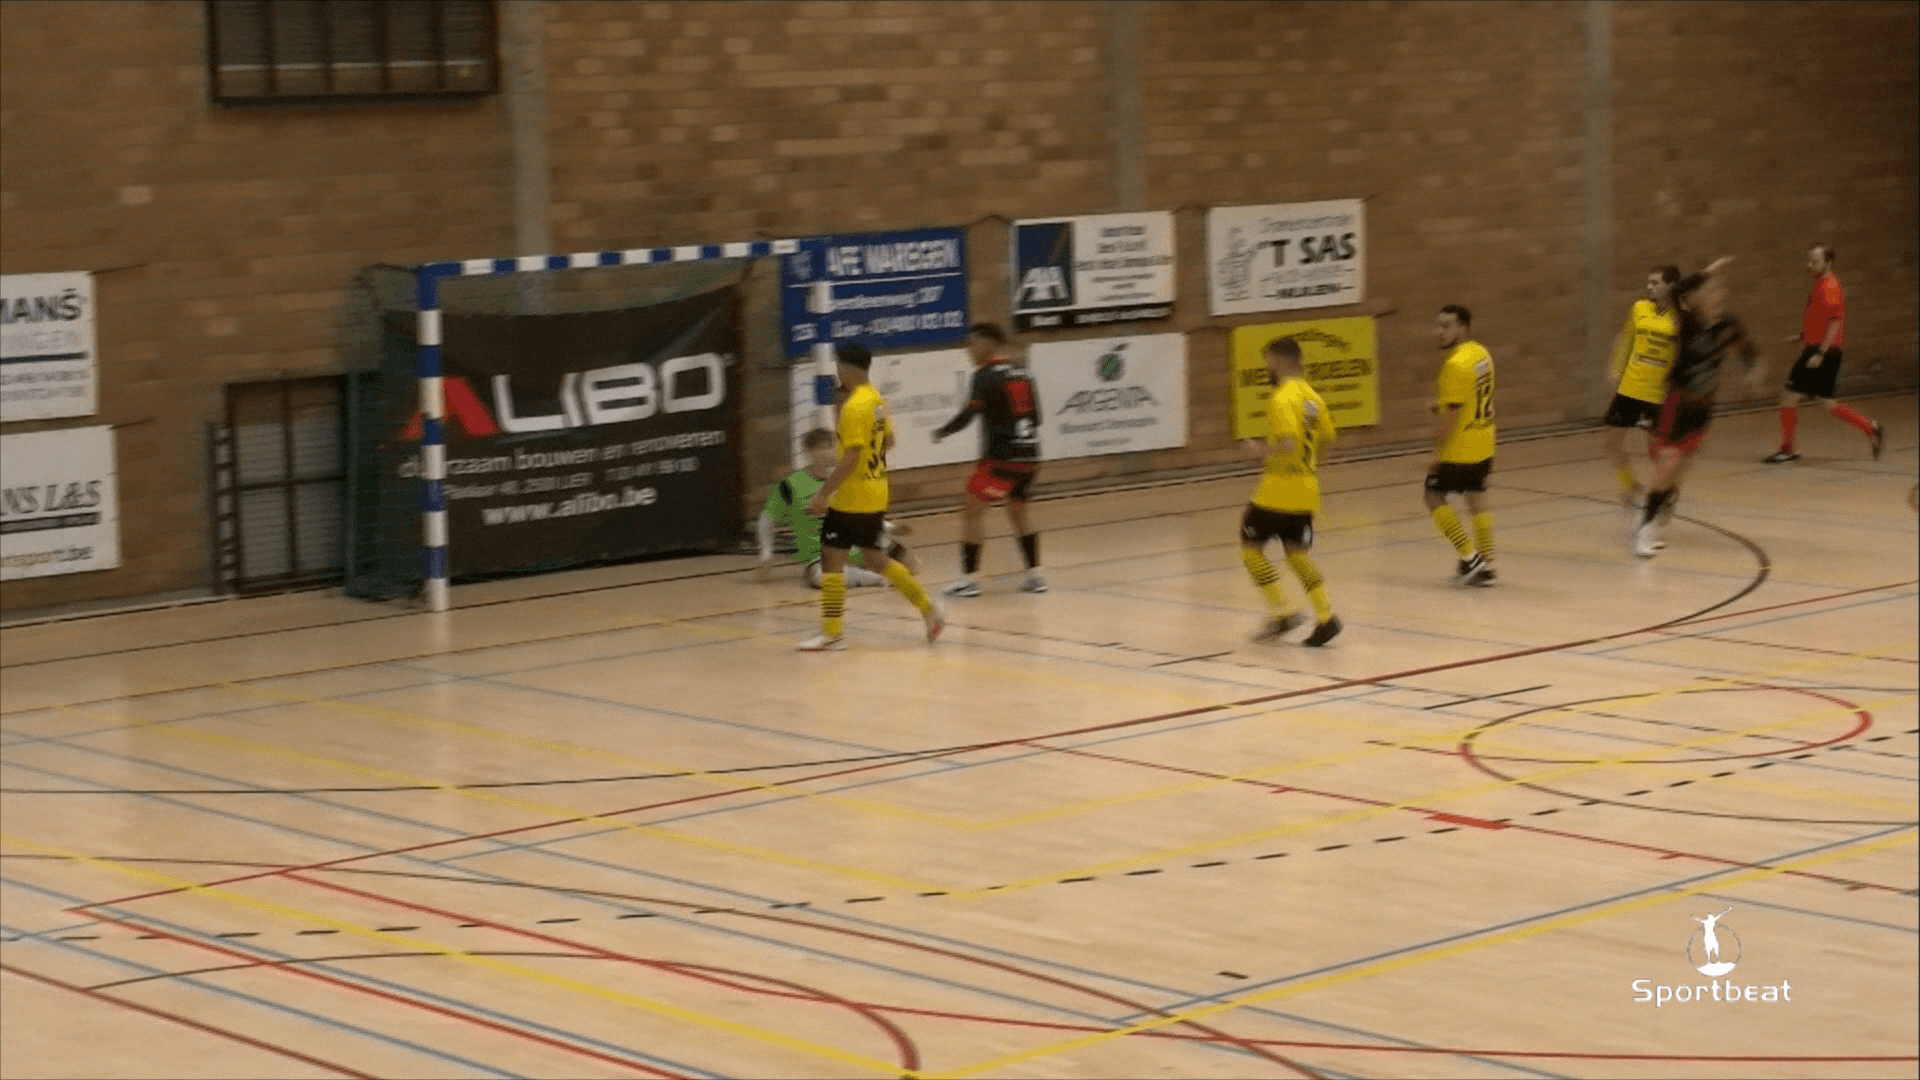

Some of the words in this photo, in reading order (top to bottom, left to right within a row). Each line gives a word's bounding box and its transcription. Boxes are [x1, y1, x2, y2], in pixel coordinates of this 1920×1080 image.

[1299, 232, 1356, 265] SAS
[402, 352, 726, 440] ALIBO
[1055, 385, 1161, 416] ARGENTA
